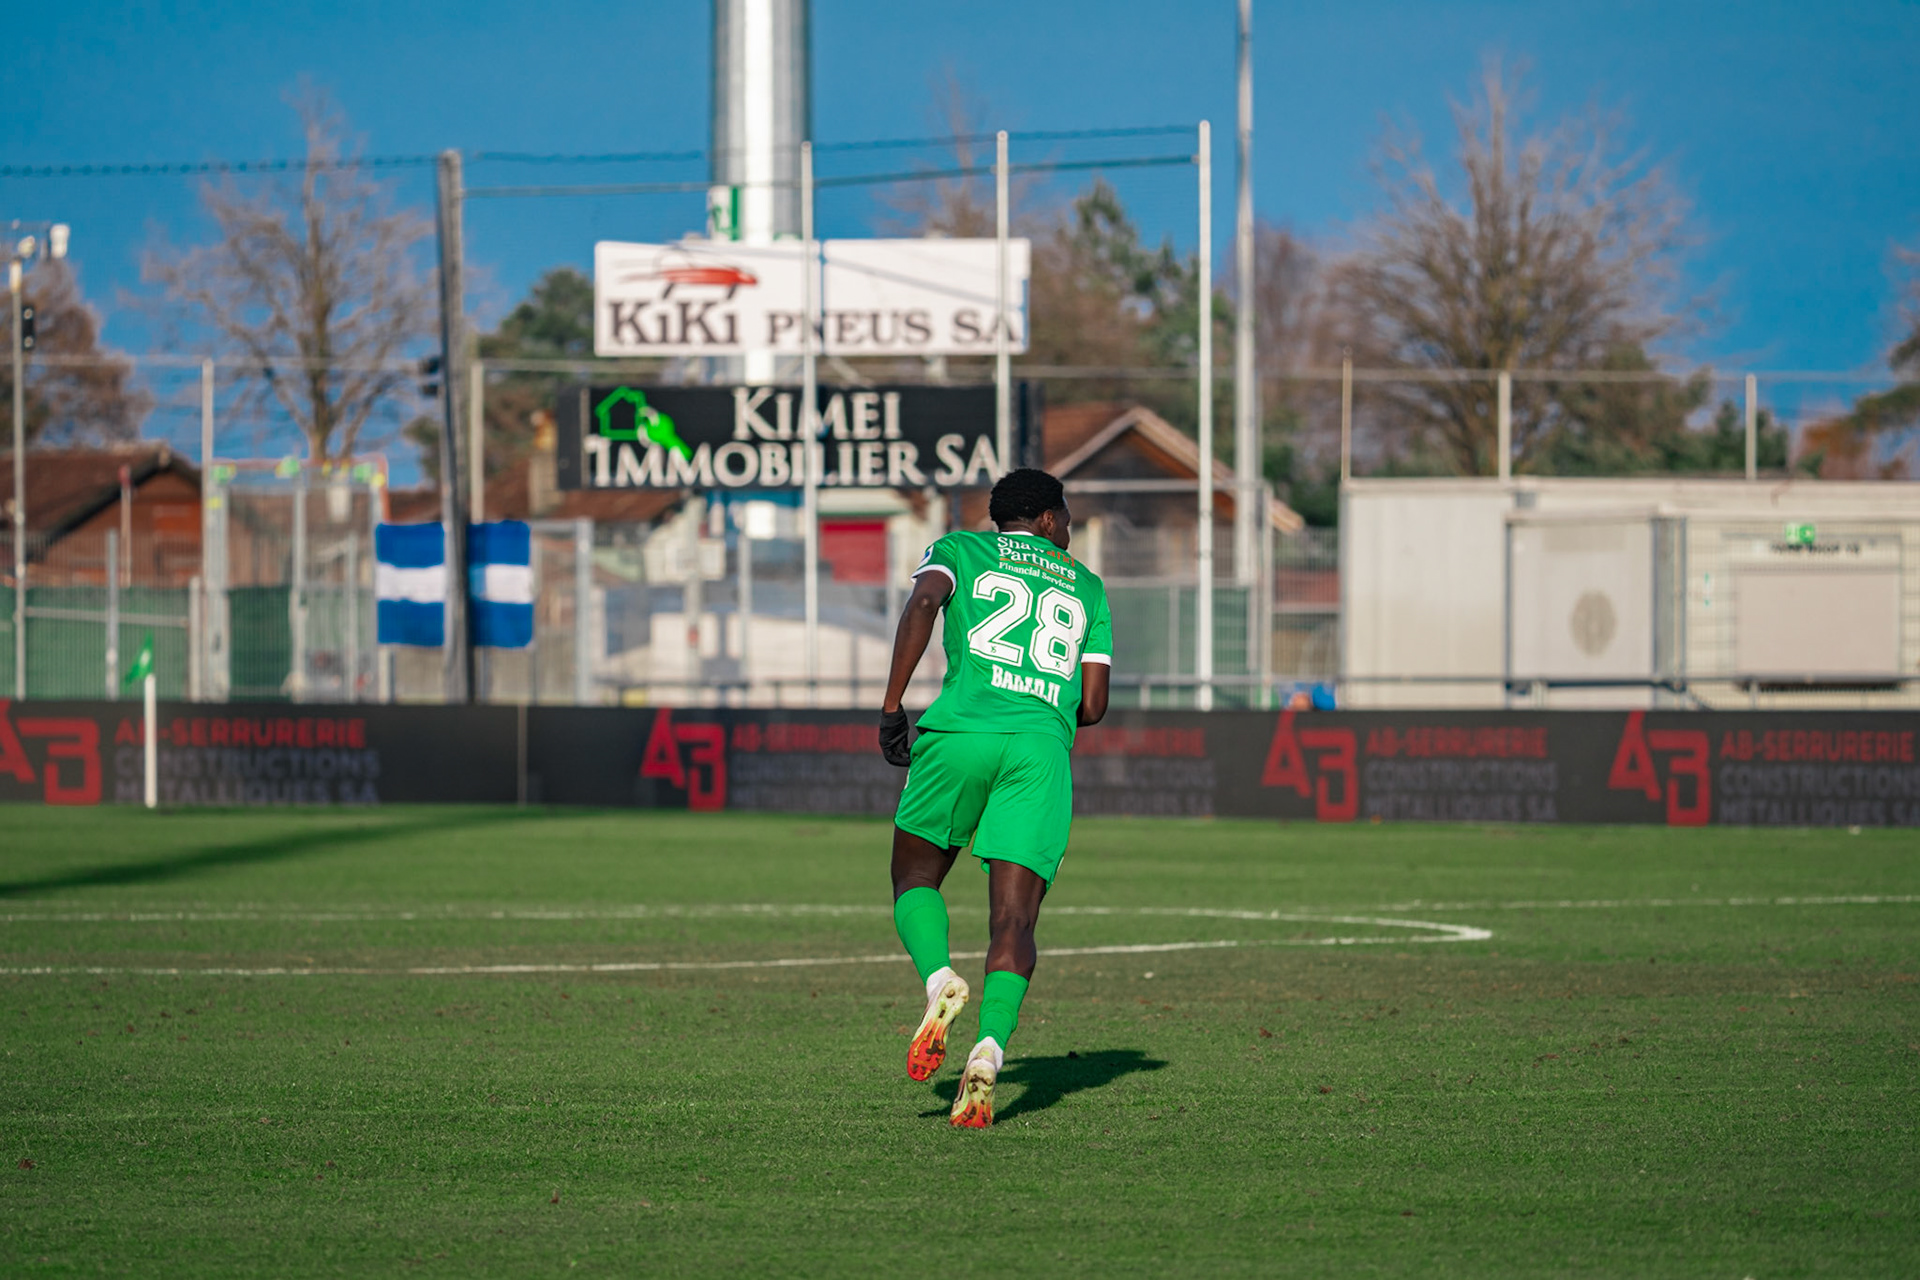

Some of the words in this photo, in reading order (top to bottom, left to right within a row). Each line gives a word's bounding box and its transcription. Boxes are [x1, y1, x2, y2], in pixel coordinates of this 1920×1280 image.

[765, 310, 932, 346] PNEUS
[951, 309, 1020, 345] SA
[588, 437, 927, 489] IMMOBILIER
[934, 434, 1000, 488] SA
[998, 547, 1076, 580] Partners
[998, 561, 1041, 578] Financial
[1041, 571, 1076, 593] Services
[966, 569, 1088, 682] 28
[115, 748, 380, 778] CNSTRUCTIONS
